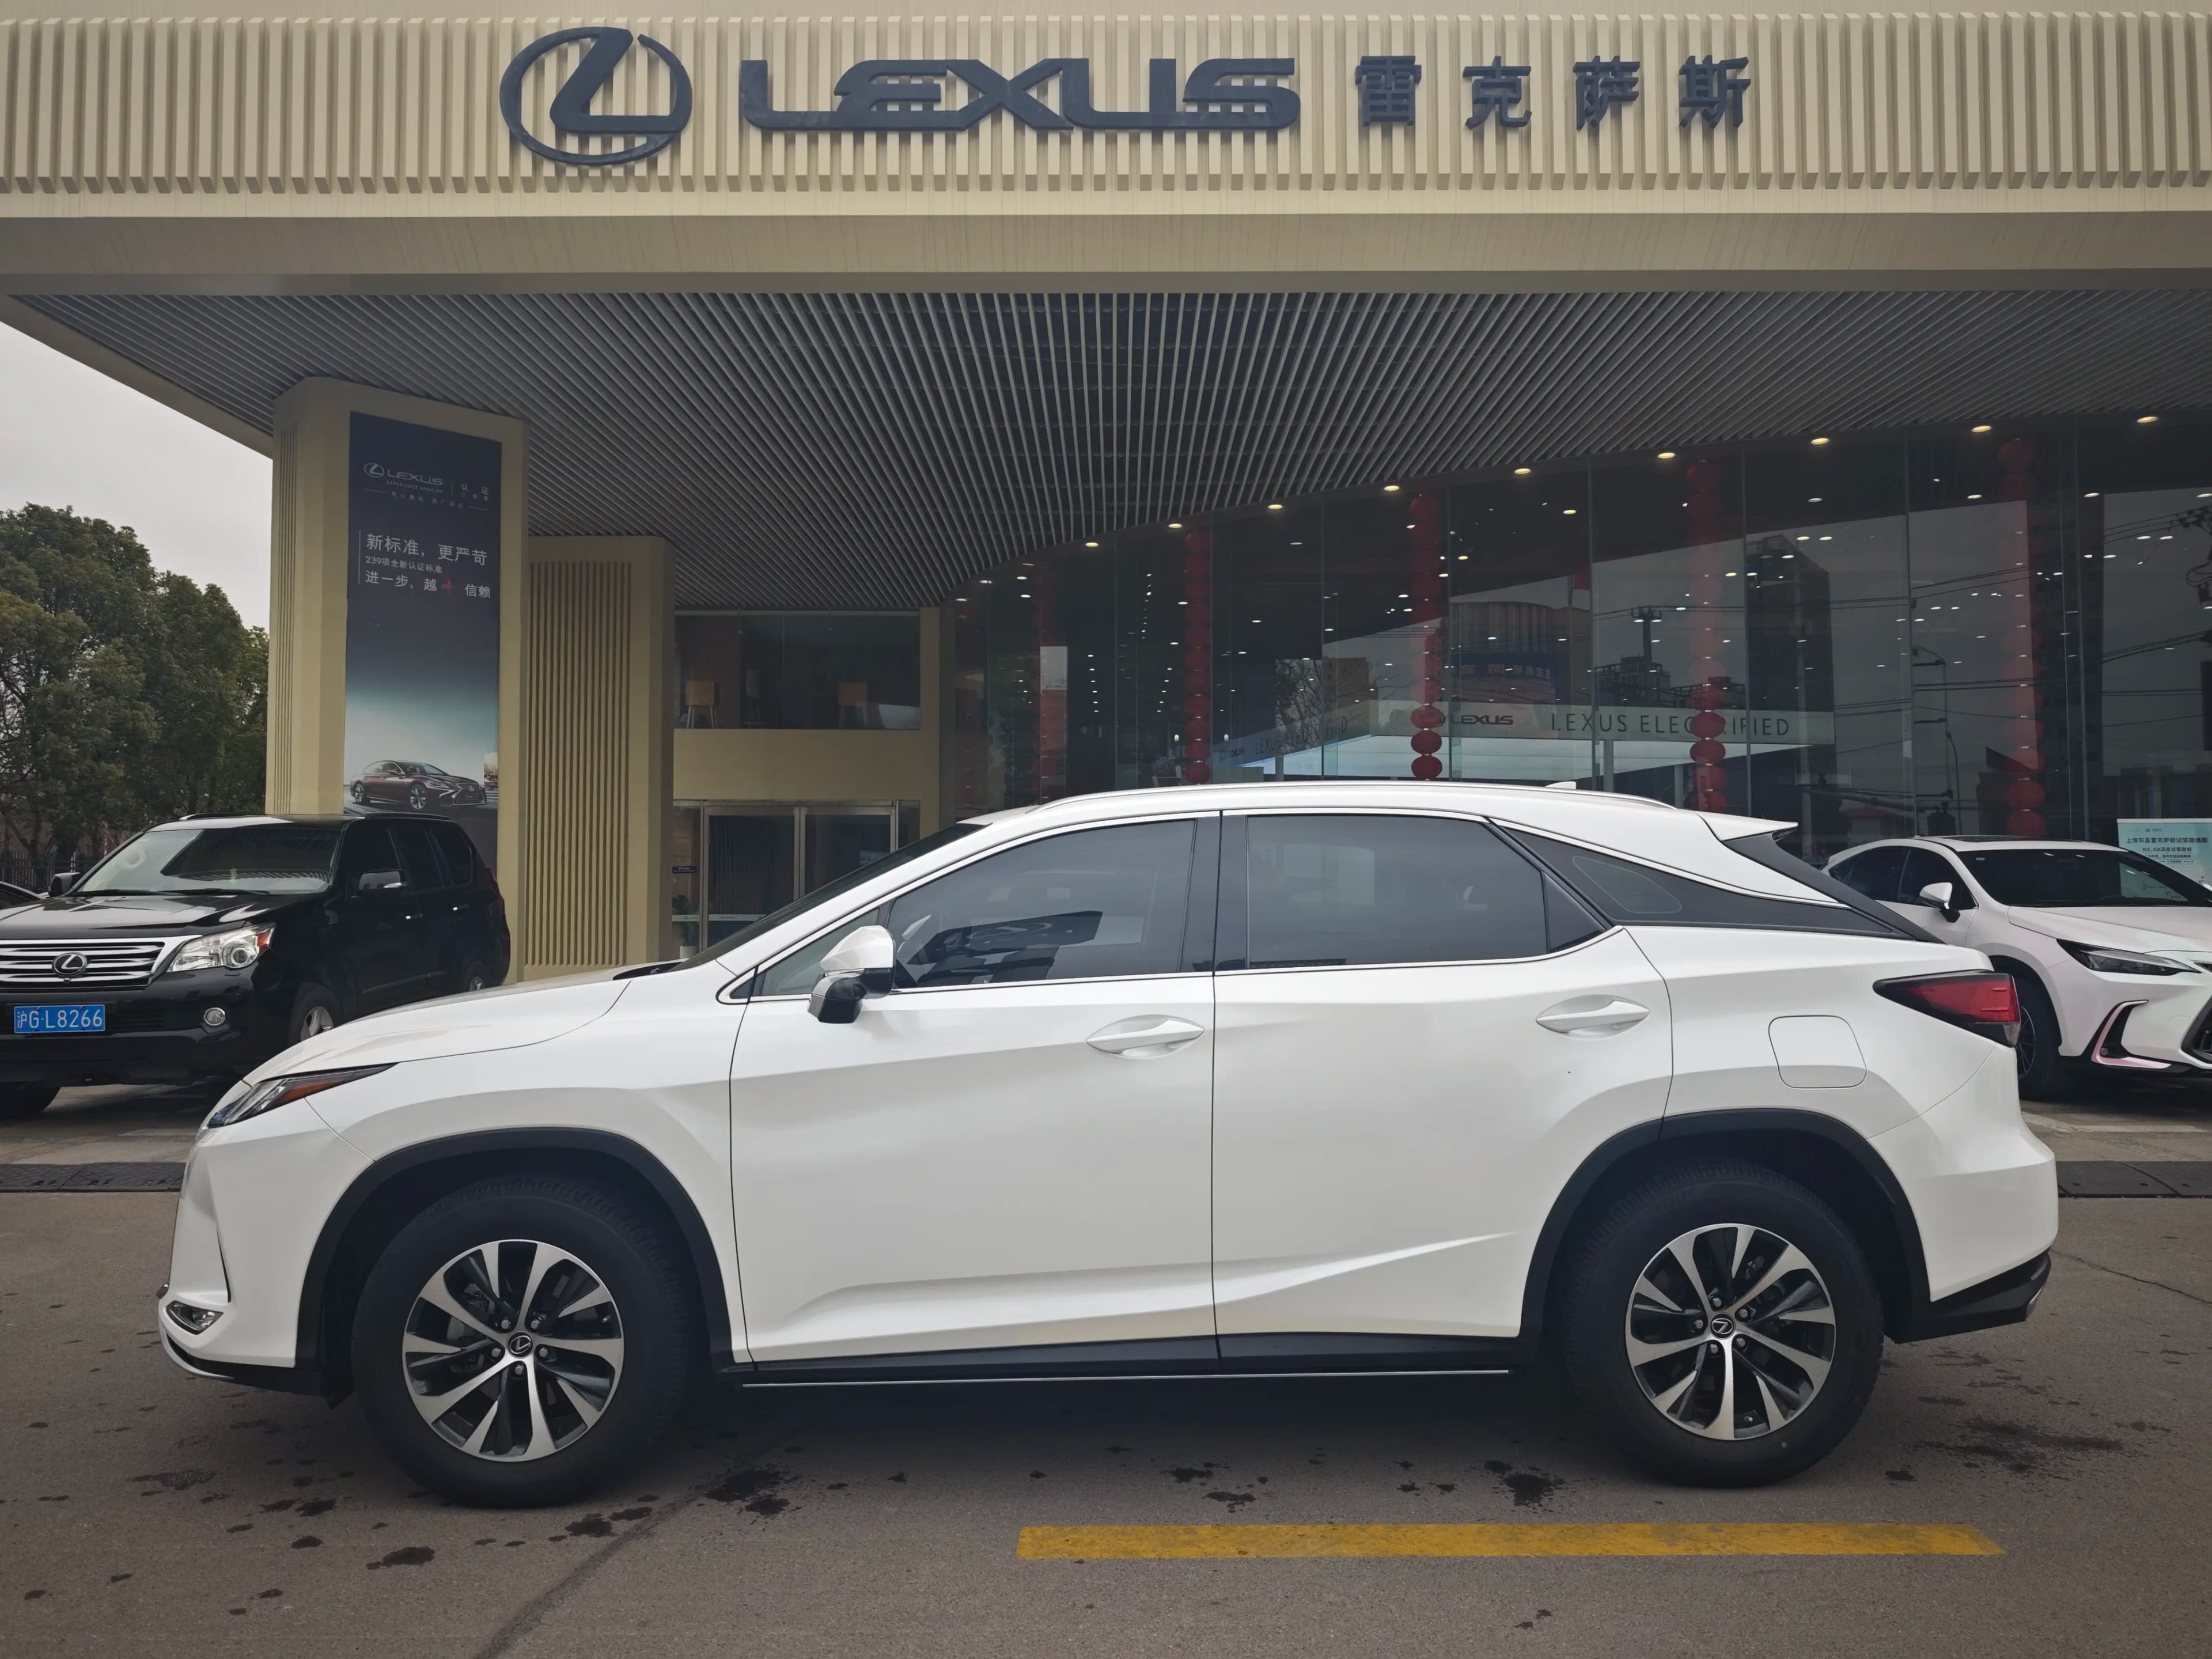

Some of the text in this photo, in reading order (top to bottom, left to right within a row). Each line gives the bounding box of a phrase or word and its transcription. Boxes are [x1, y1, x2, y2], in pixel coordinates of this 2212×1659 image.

[740, 56, 1301, 132] LEXUS
[1354, 54, 1751, 130] 雷克萨斯
[387, 469, 442, 485] LEXUS
[365, 555, 443, 574] 239项全新认证标准
[1451, 714, 1514, 725] LEXUS
[1551, 713, 1789, 736] LEXUS ELECIFIED
